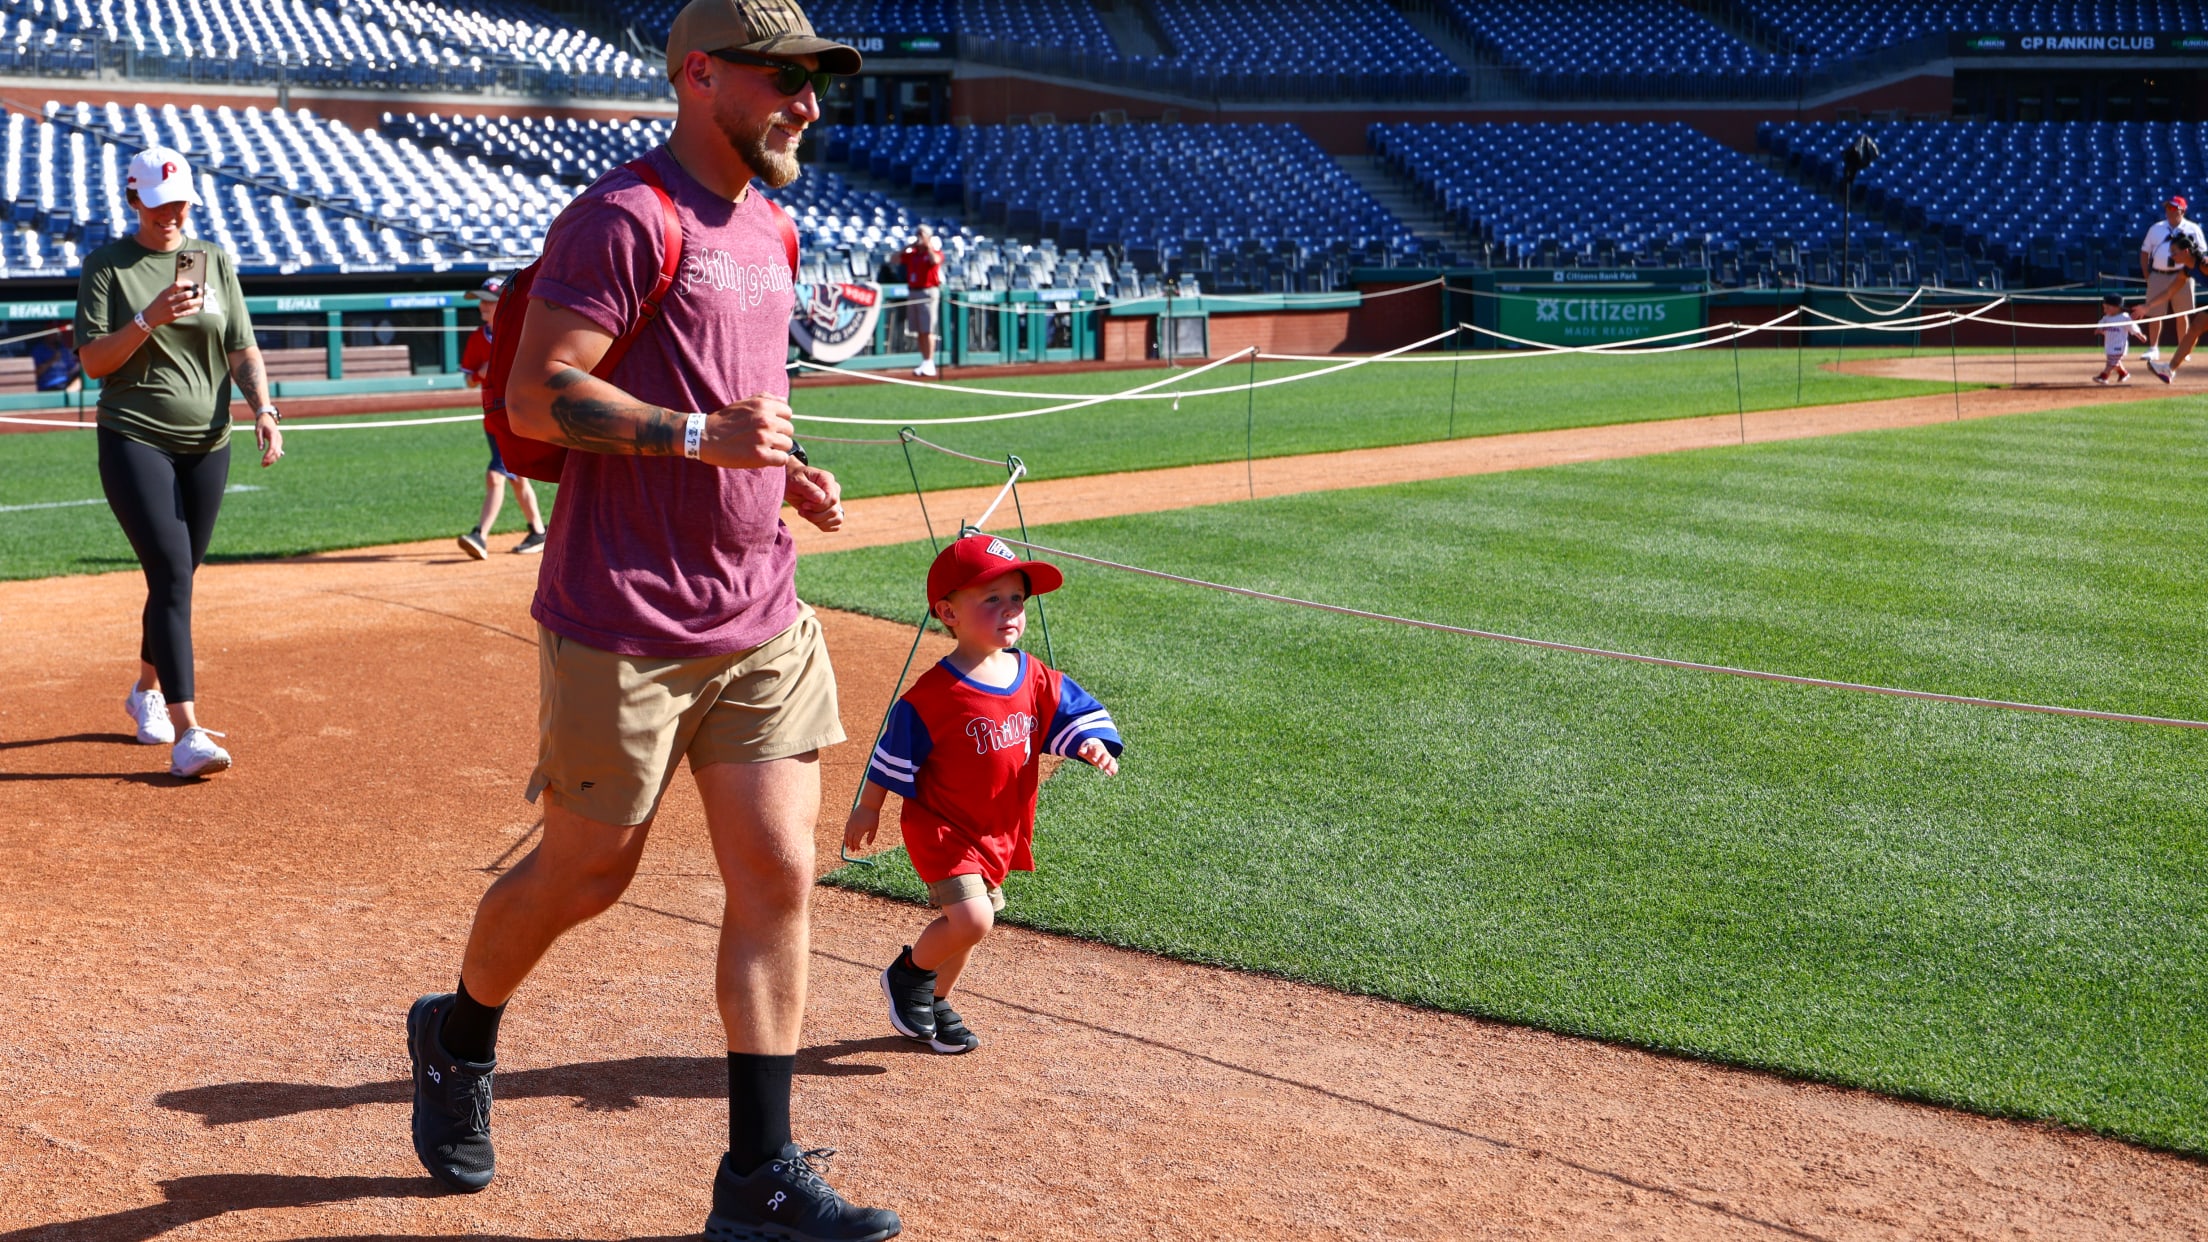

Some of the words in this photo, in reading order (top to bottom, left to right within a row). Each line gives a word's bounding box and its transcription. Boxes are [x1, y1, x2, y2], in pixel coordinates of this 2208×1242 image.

[2021, 36, 2043, 50] CP
[2046, 36, 2104, 50] RANKIN
[2107, 36, 2155, 50] CLUB
[1566, 271, 1598, 281] Citizens
[1599, 271, 1618, 281] Bank
[1620, 271, 1637, 281] Park
[9, 303, 60, 319] RE/MAX
[1564, 299, 1666, 321] Citizens
[1564, 327, 1598, 336] MADE
[965, 712, 1038, 755] Phillis
